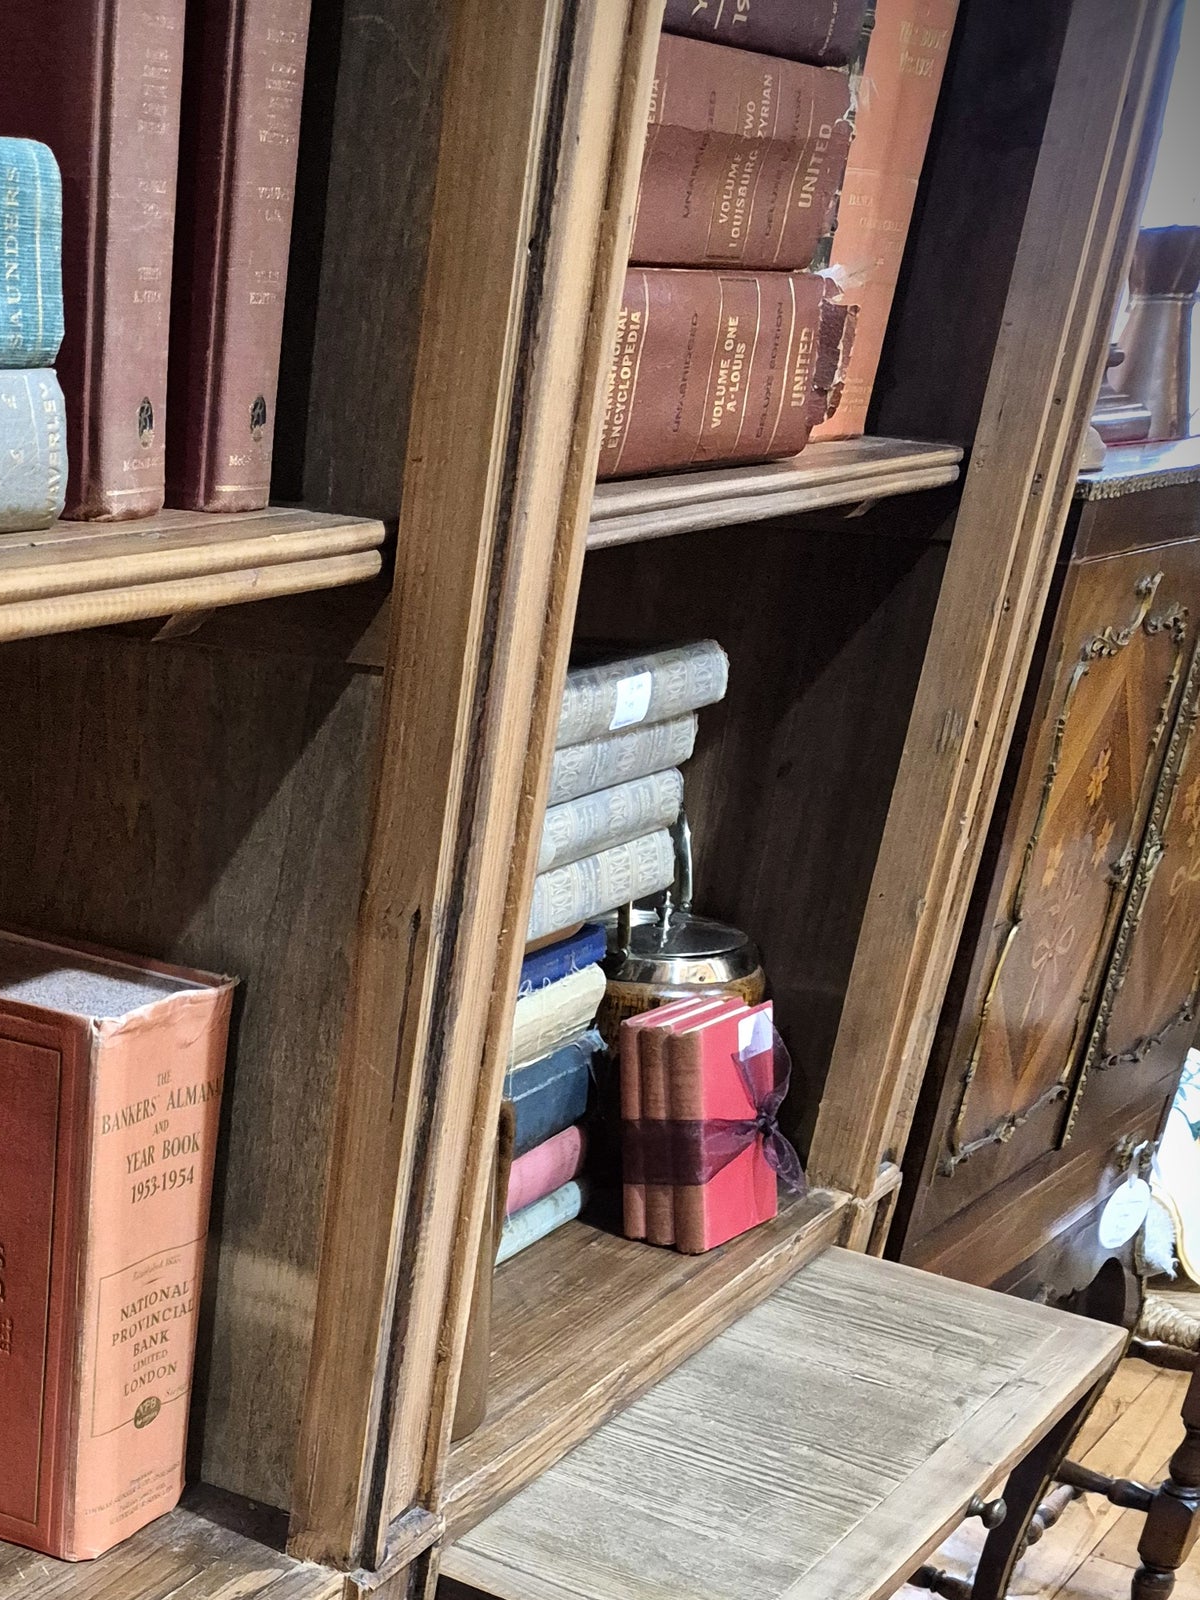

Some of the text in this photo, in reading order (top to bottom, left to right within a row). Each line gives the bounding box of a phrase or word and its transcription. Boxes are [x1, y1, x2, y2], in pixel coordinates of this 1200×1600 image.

[798, 124, 833, 208] UNITED
[719, 152, 742, 224] VOLUME
[3, 166, 23, 350] SAUNDERS
[608, 311, 641, 449] ENCYCLOPEDIA
[711, 316, 739, 428] VOLUME ONE
[726, 342, 746, 412] A-LOUIS
[157, 1070, 172, 1087] THE
[152, 1120, 170, 1136] AND
[126, 1131, 201, 1174] YEAR BOOK
[131, 1165, 194, 1204] 1953-1954
[112, 1299, 194, 1347] PROVINCIAL
[120, 1281, 190, 1322] NATIONAL
[133, 1329, 170, 1357] BANK
[133, 1349, 168, 1373] LIMITED
[124, 1361, 178, 1397] LONDON
